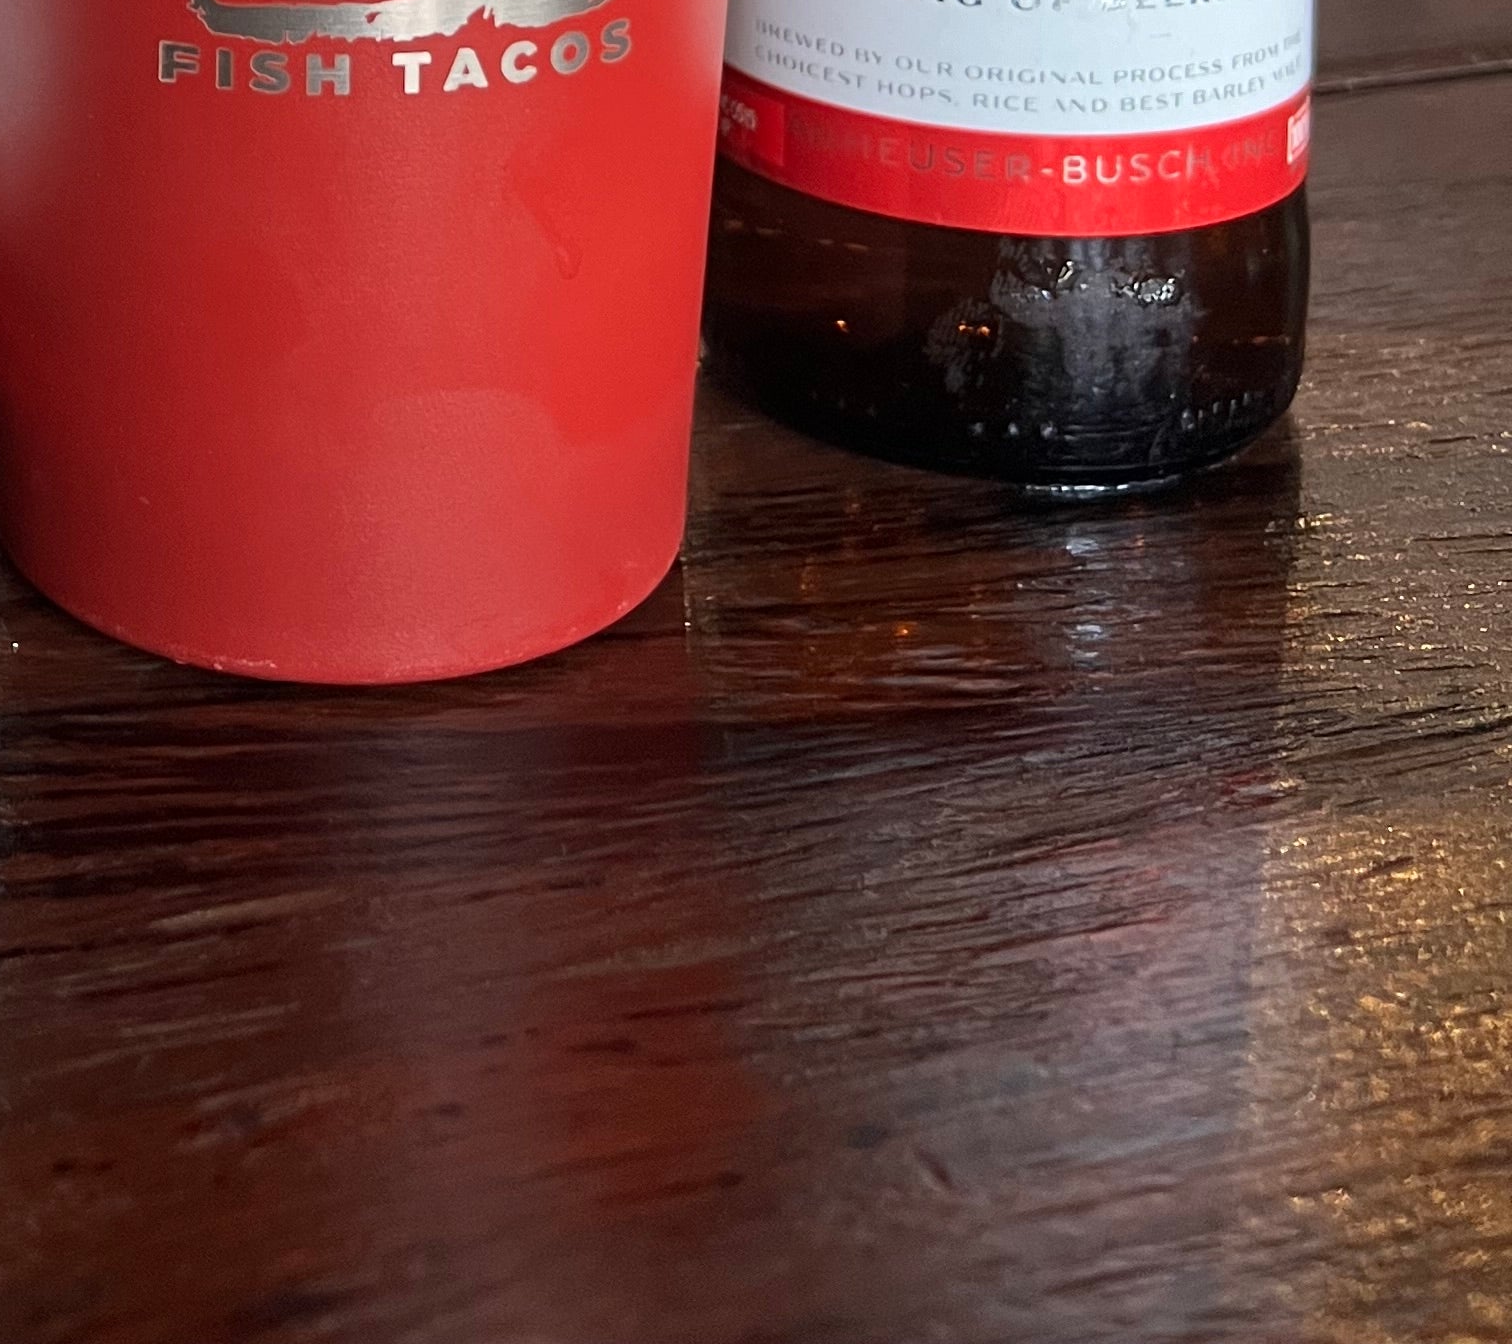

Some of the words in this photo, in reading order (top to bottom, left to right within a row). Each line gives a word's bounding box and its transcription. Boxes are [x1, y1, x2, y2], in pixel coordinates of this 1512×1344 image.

[158, 40, 351, 96] FISH
[392, 19, 631, 95] TACOS
[755, 19, 844, 57] BREWED
[855, 47, 883, 65] BY
[895, 55, 953, 77] OUR
[965, 65, 1103, 85] ORIGINAL
[1114, 58, 1223, 85] PROCESS
[755, 44, 867, 89] CHOICEST
[973, 93, 1038, 112] RICE
[1056, 97, 1108, 113] AND
[1121, 92, 1184, 112] BEST
